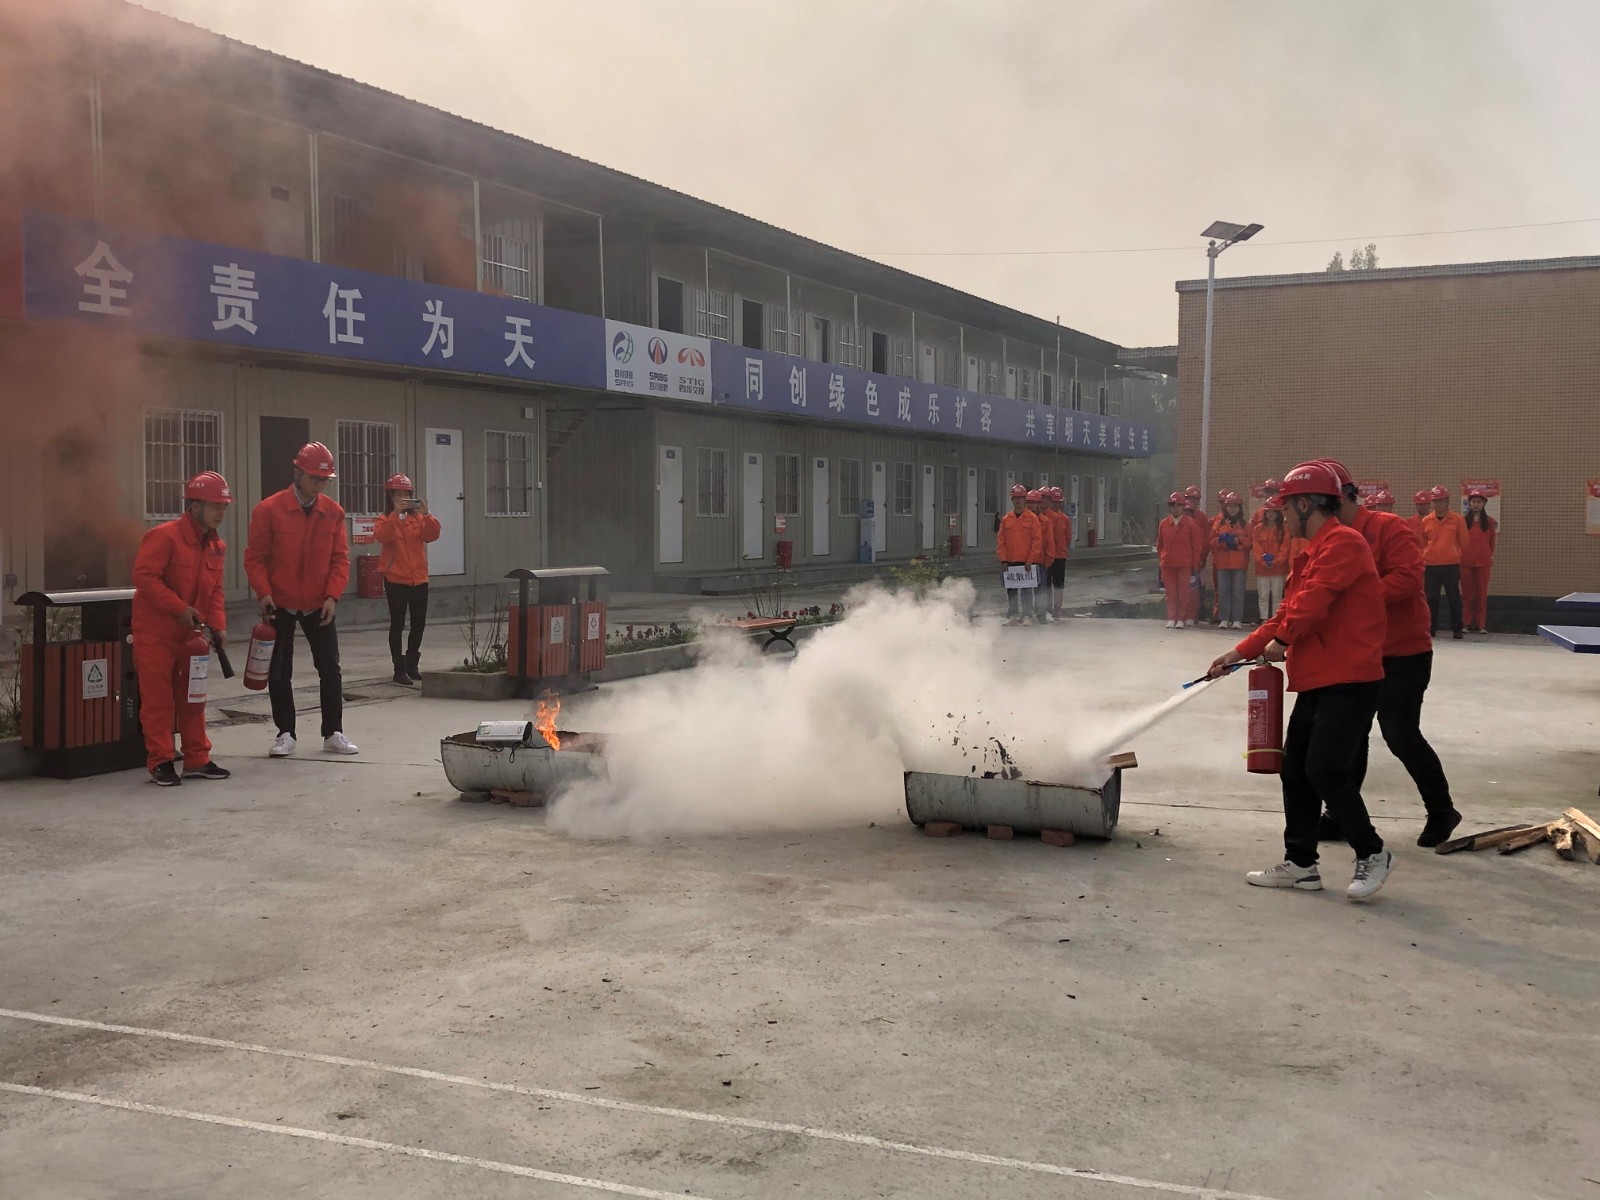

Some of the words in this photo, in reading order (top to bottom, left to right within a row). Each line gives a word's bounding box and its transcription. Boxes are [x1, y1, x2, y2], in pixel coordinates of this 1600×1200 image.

[679, 377, 705, 387] STIG
[745, 357, 992, 434] 同创绿色成乐扩容
[1025, 409, 1149, 451] 共享明天美好生活
